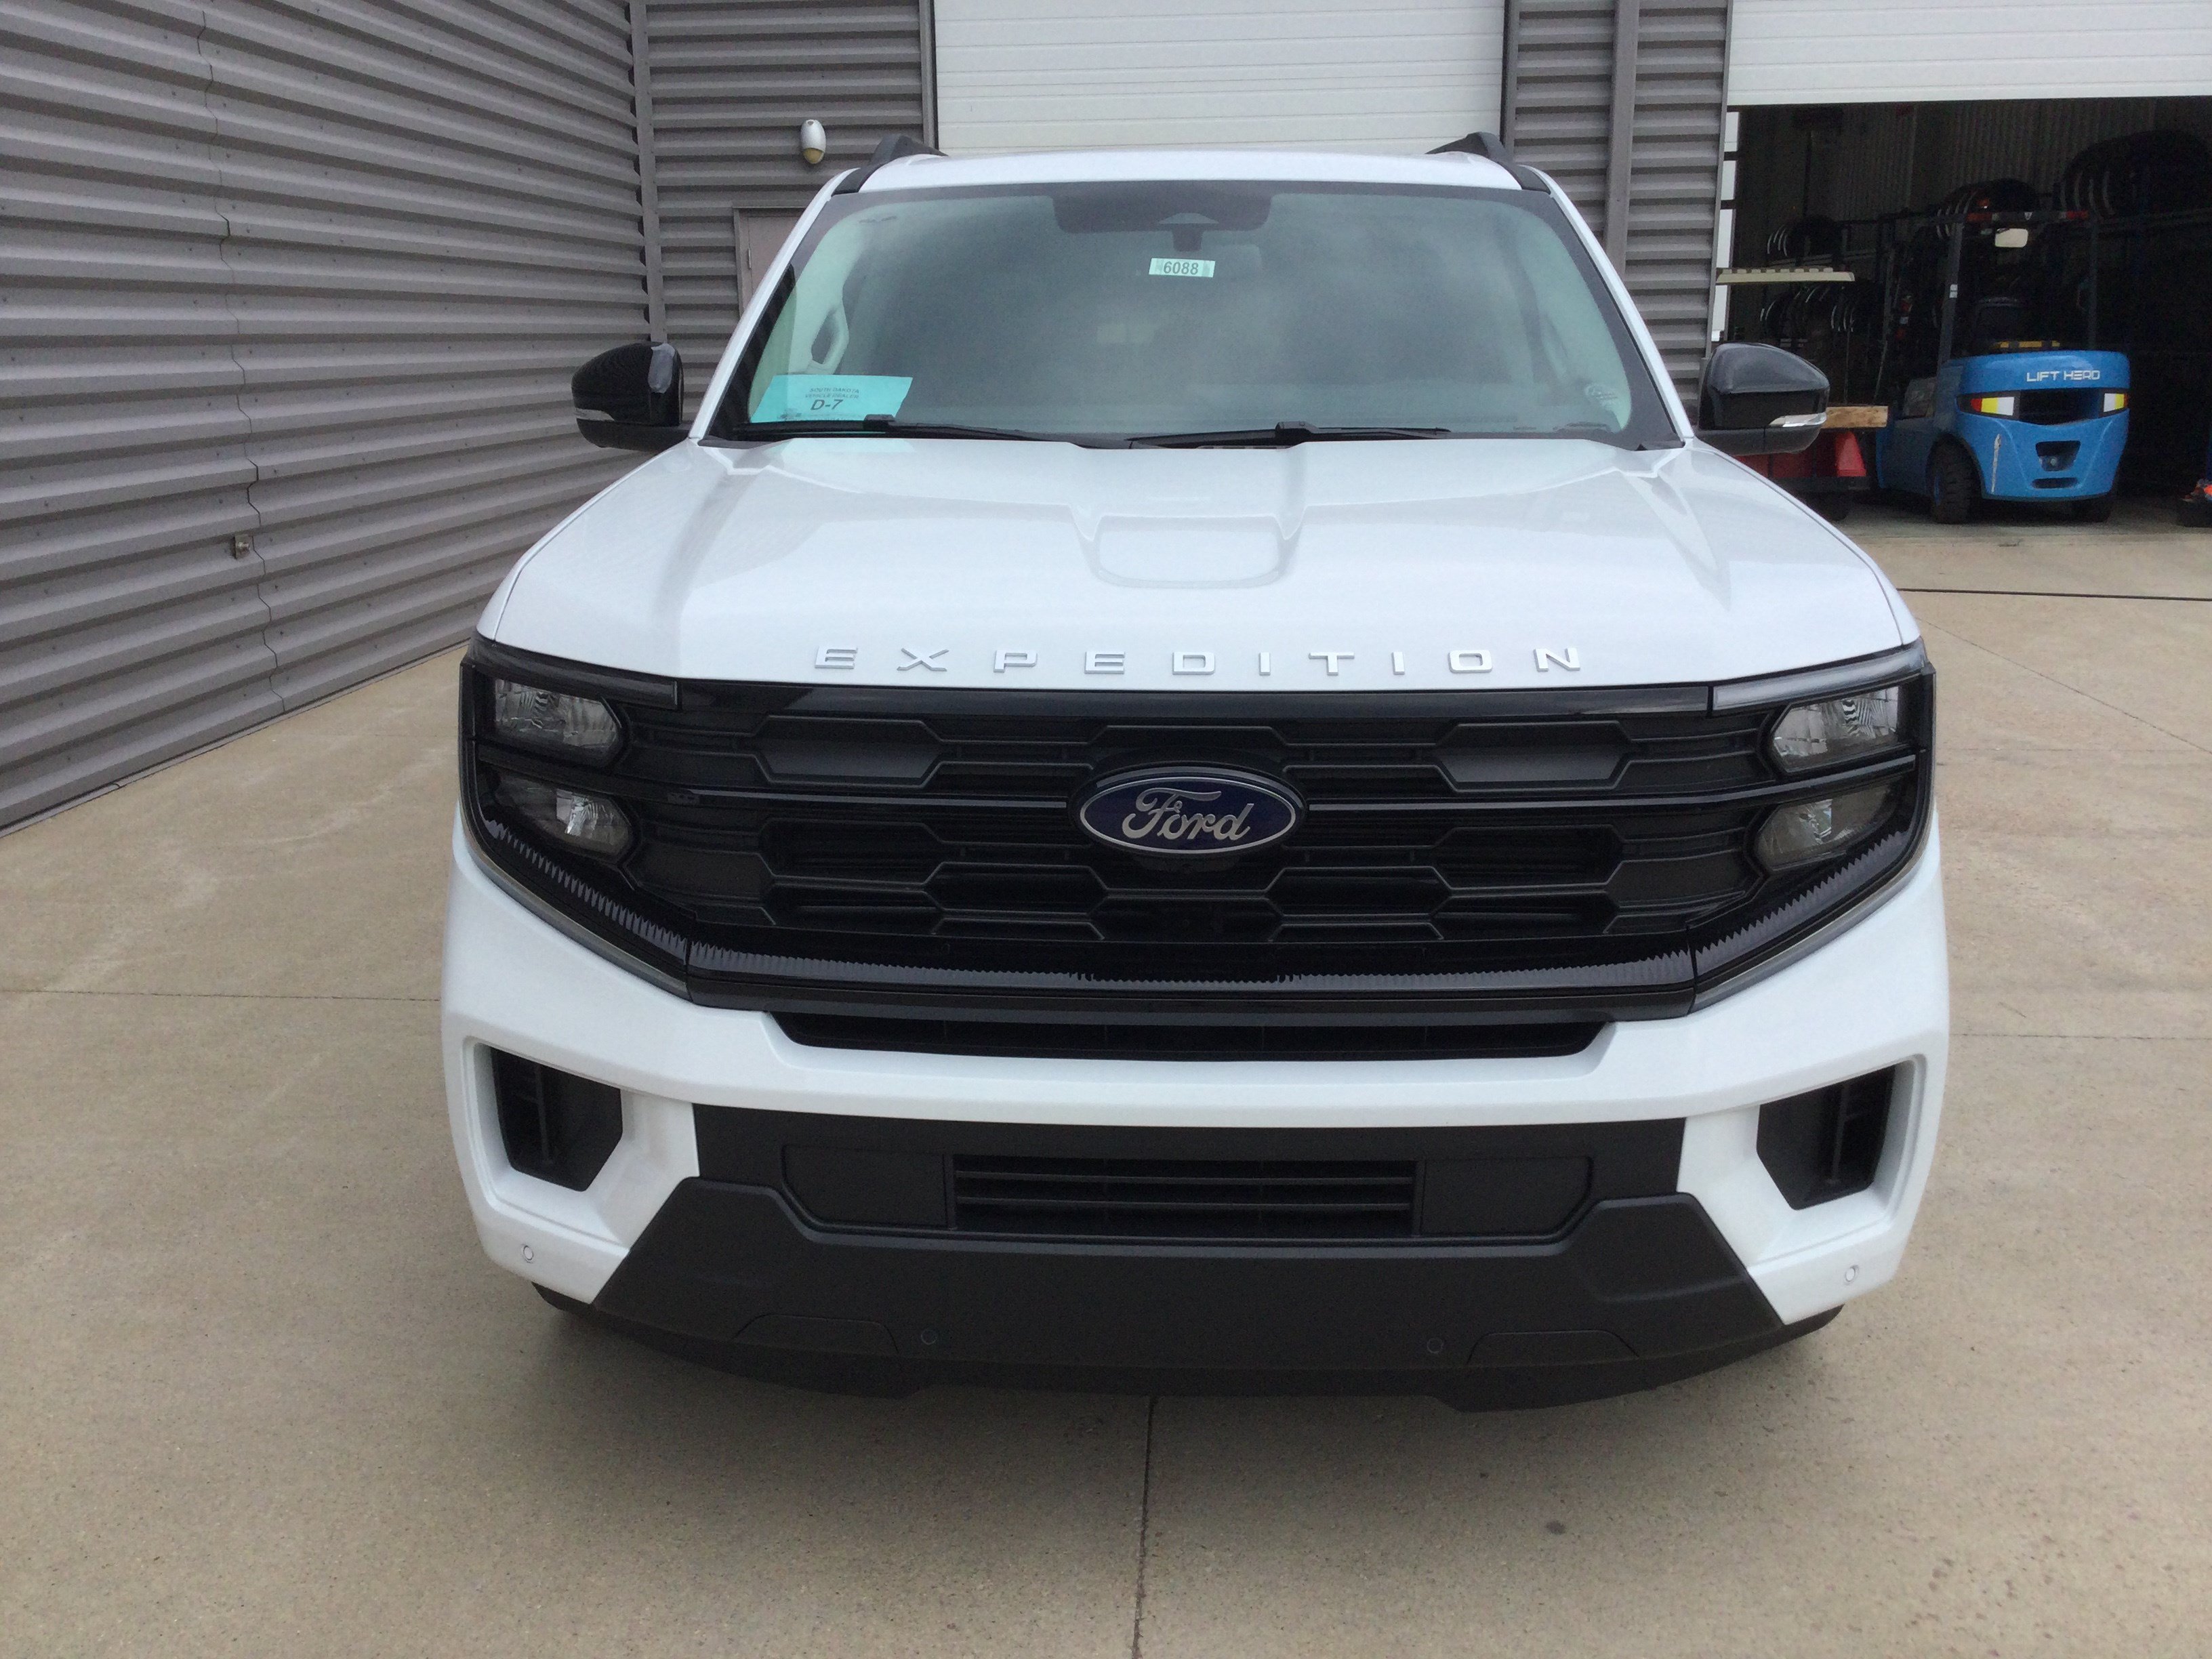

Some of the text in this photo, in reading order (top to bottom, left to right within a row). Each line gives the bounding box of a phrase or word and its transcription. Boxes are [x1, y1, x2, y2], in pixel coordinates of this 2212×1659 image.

[1164, 261, 1199, 275] 6088
[2026, 369, 2100, 382] LIFT HERO
[811, 399, 844, 410] D-7
[815, 646, 1580, 676] EXPEDITION
[1122, 787, 1254, 841] Ford
